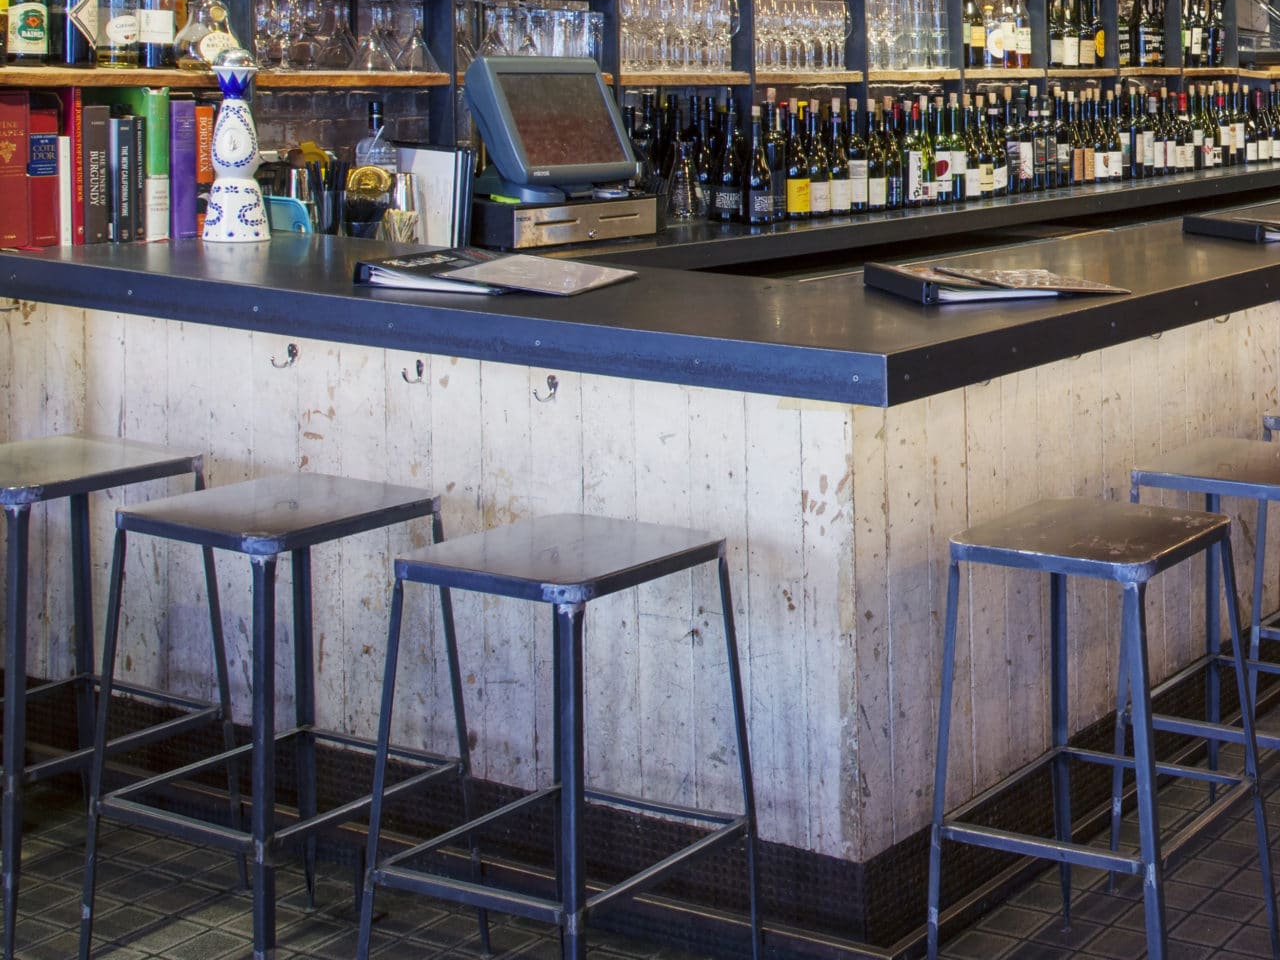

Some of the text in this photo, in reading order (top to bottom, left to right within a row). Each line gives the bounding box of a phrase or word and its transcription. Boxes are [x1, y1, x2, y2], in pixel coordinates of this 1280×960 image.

[199, 117, 209, 172] BORDEAUX
[90, 151, 100, 206] BURGUNDY
[99, 195, 106, 206] OF
[121, 146, 129, 217] THE NEW CALIFORNIA WINE
